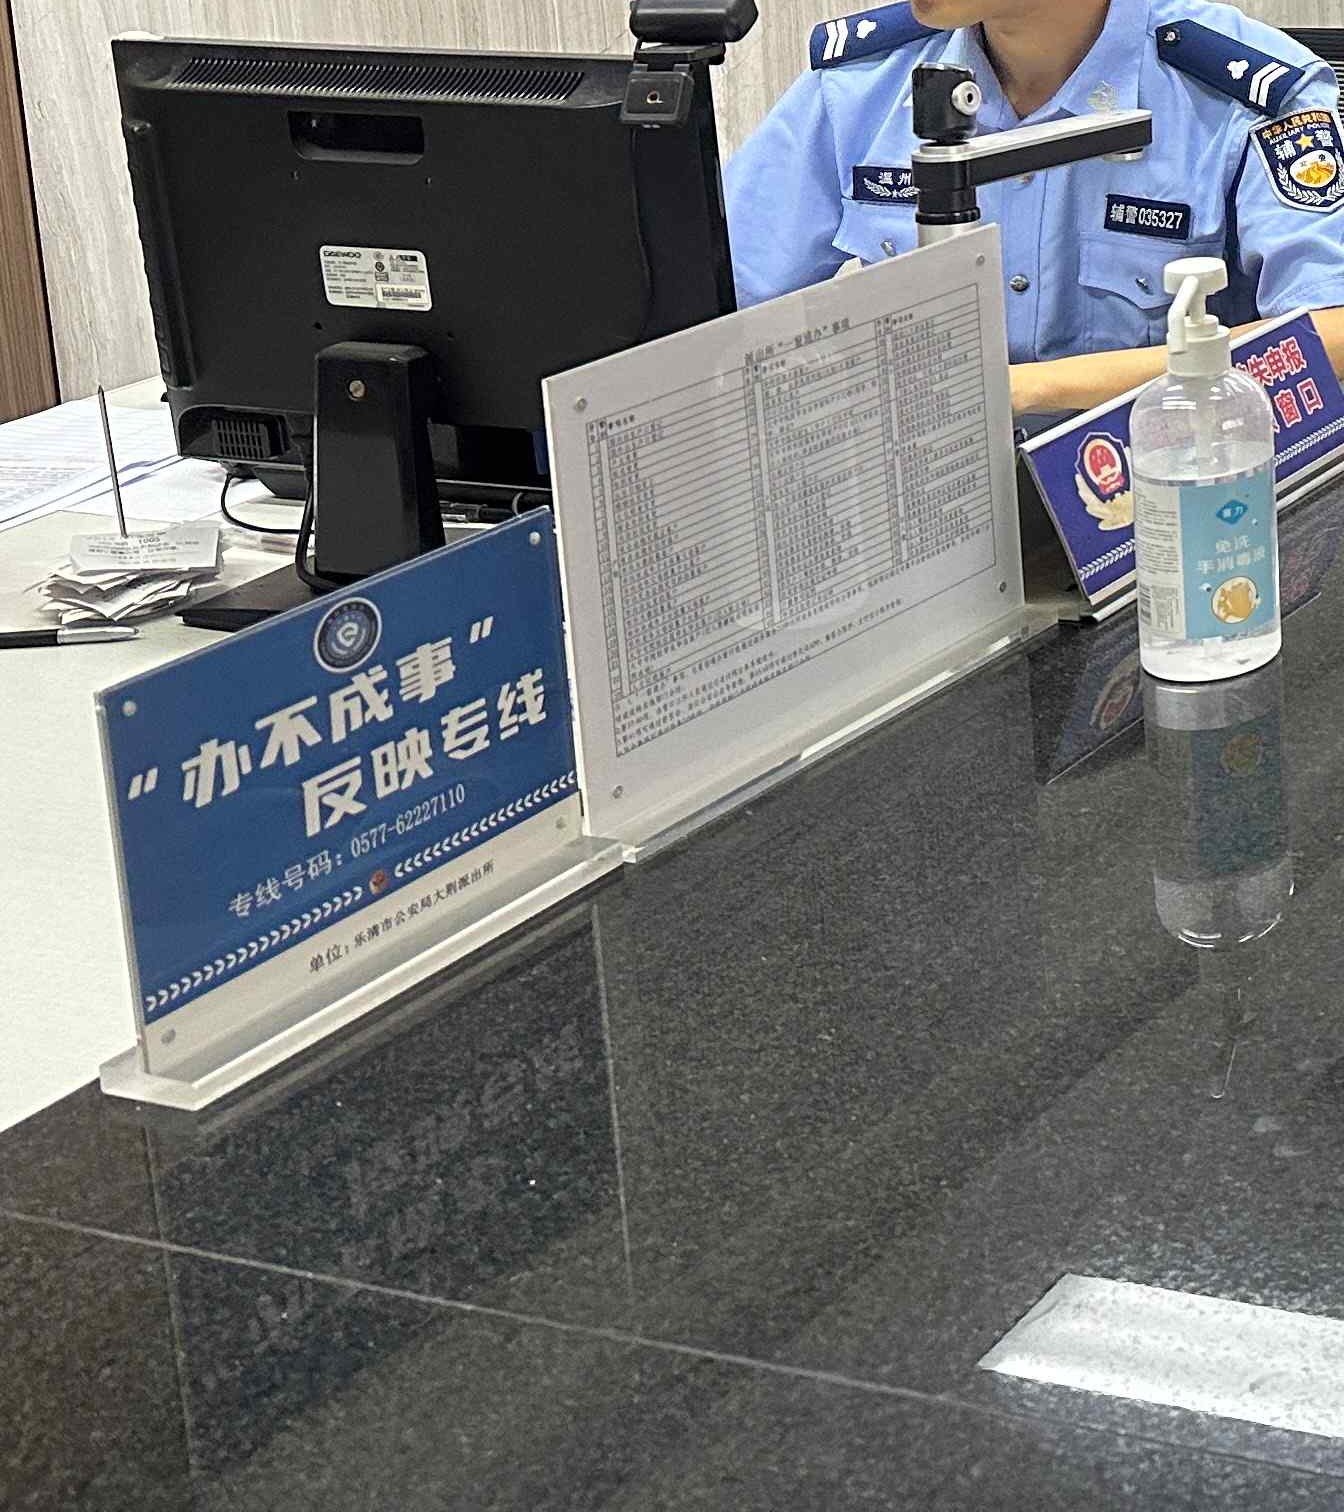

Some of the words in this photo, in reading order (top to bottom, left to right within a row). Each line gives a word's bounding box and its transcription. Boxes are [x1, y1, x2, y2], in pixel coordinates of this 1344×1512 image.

[1109, 203, 1184, 230] 辅警035327
[1234, 336, 1307, 386] 失申报
[1272, 377, 1324, 433] 窗口
[301, 667, 548, 839] 反映专线
